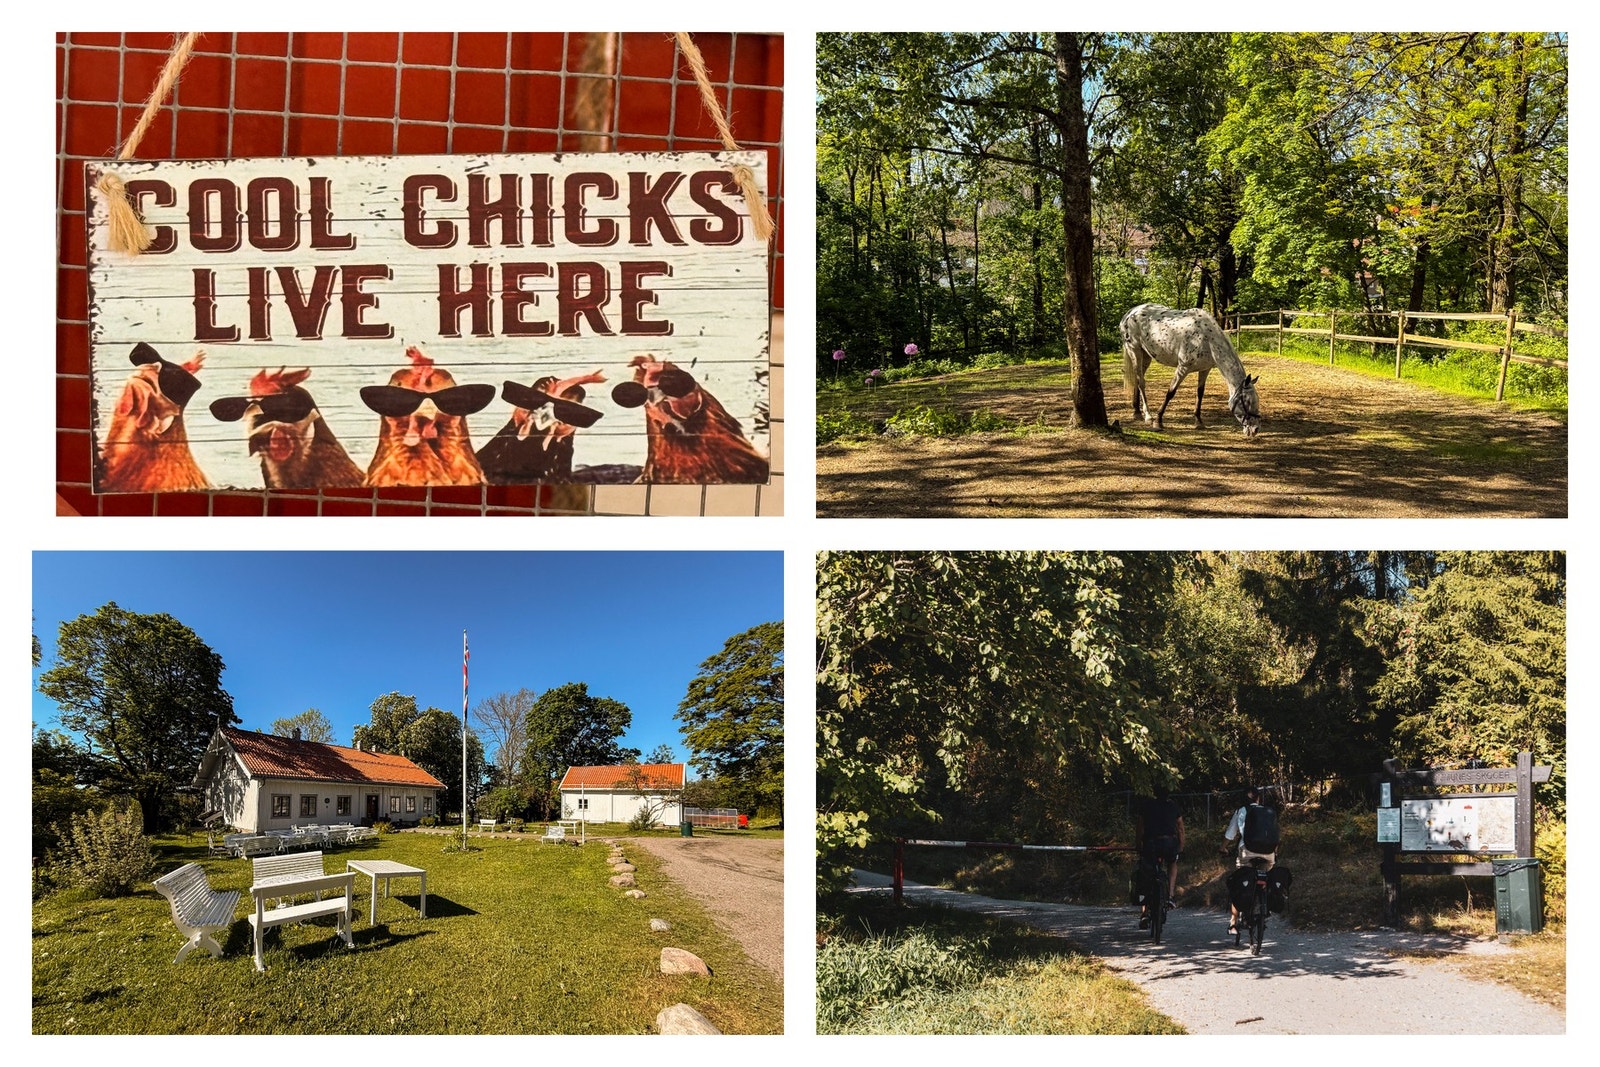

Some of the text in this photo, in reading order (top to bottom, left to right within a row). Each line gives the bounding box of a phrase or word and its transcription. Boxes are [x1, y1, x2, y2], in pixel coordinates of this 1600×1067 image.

[124, 171, 744, 255] COOL CHICKS
[192, 261, 674, 342] LIVE HERE
